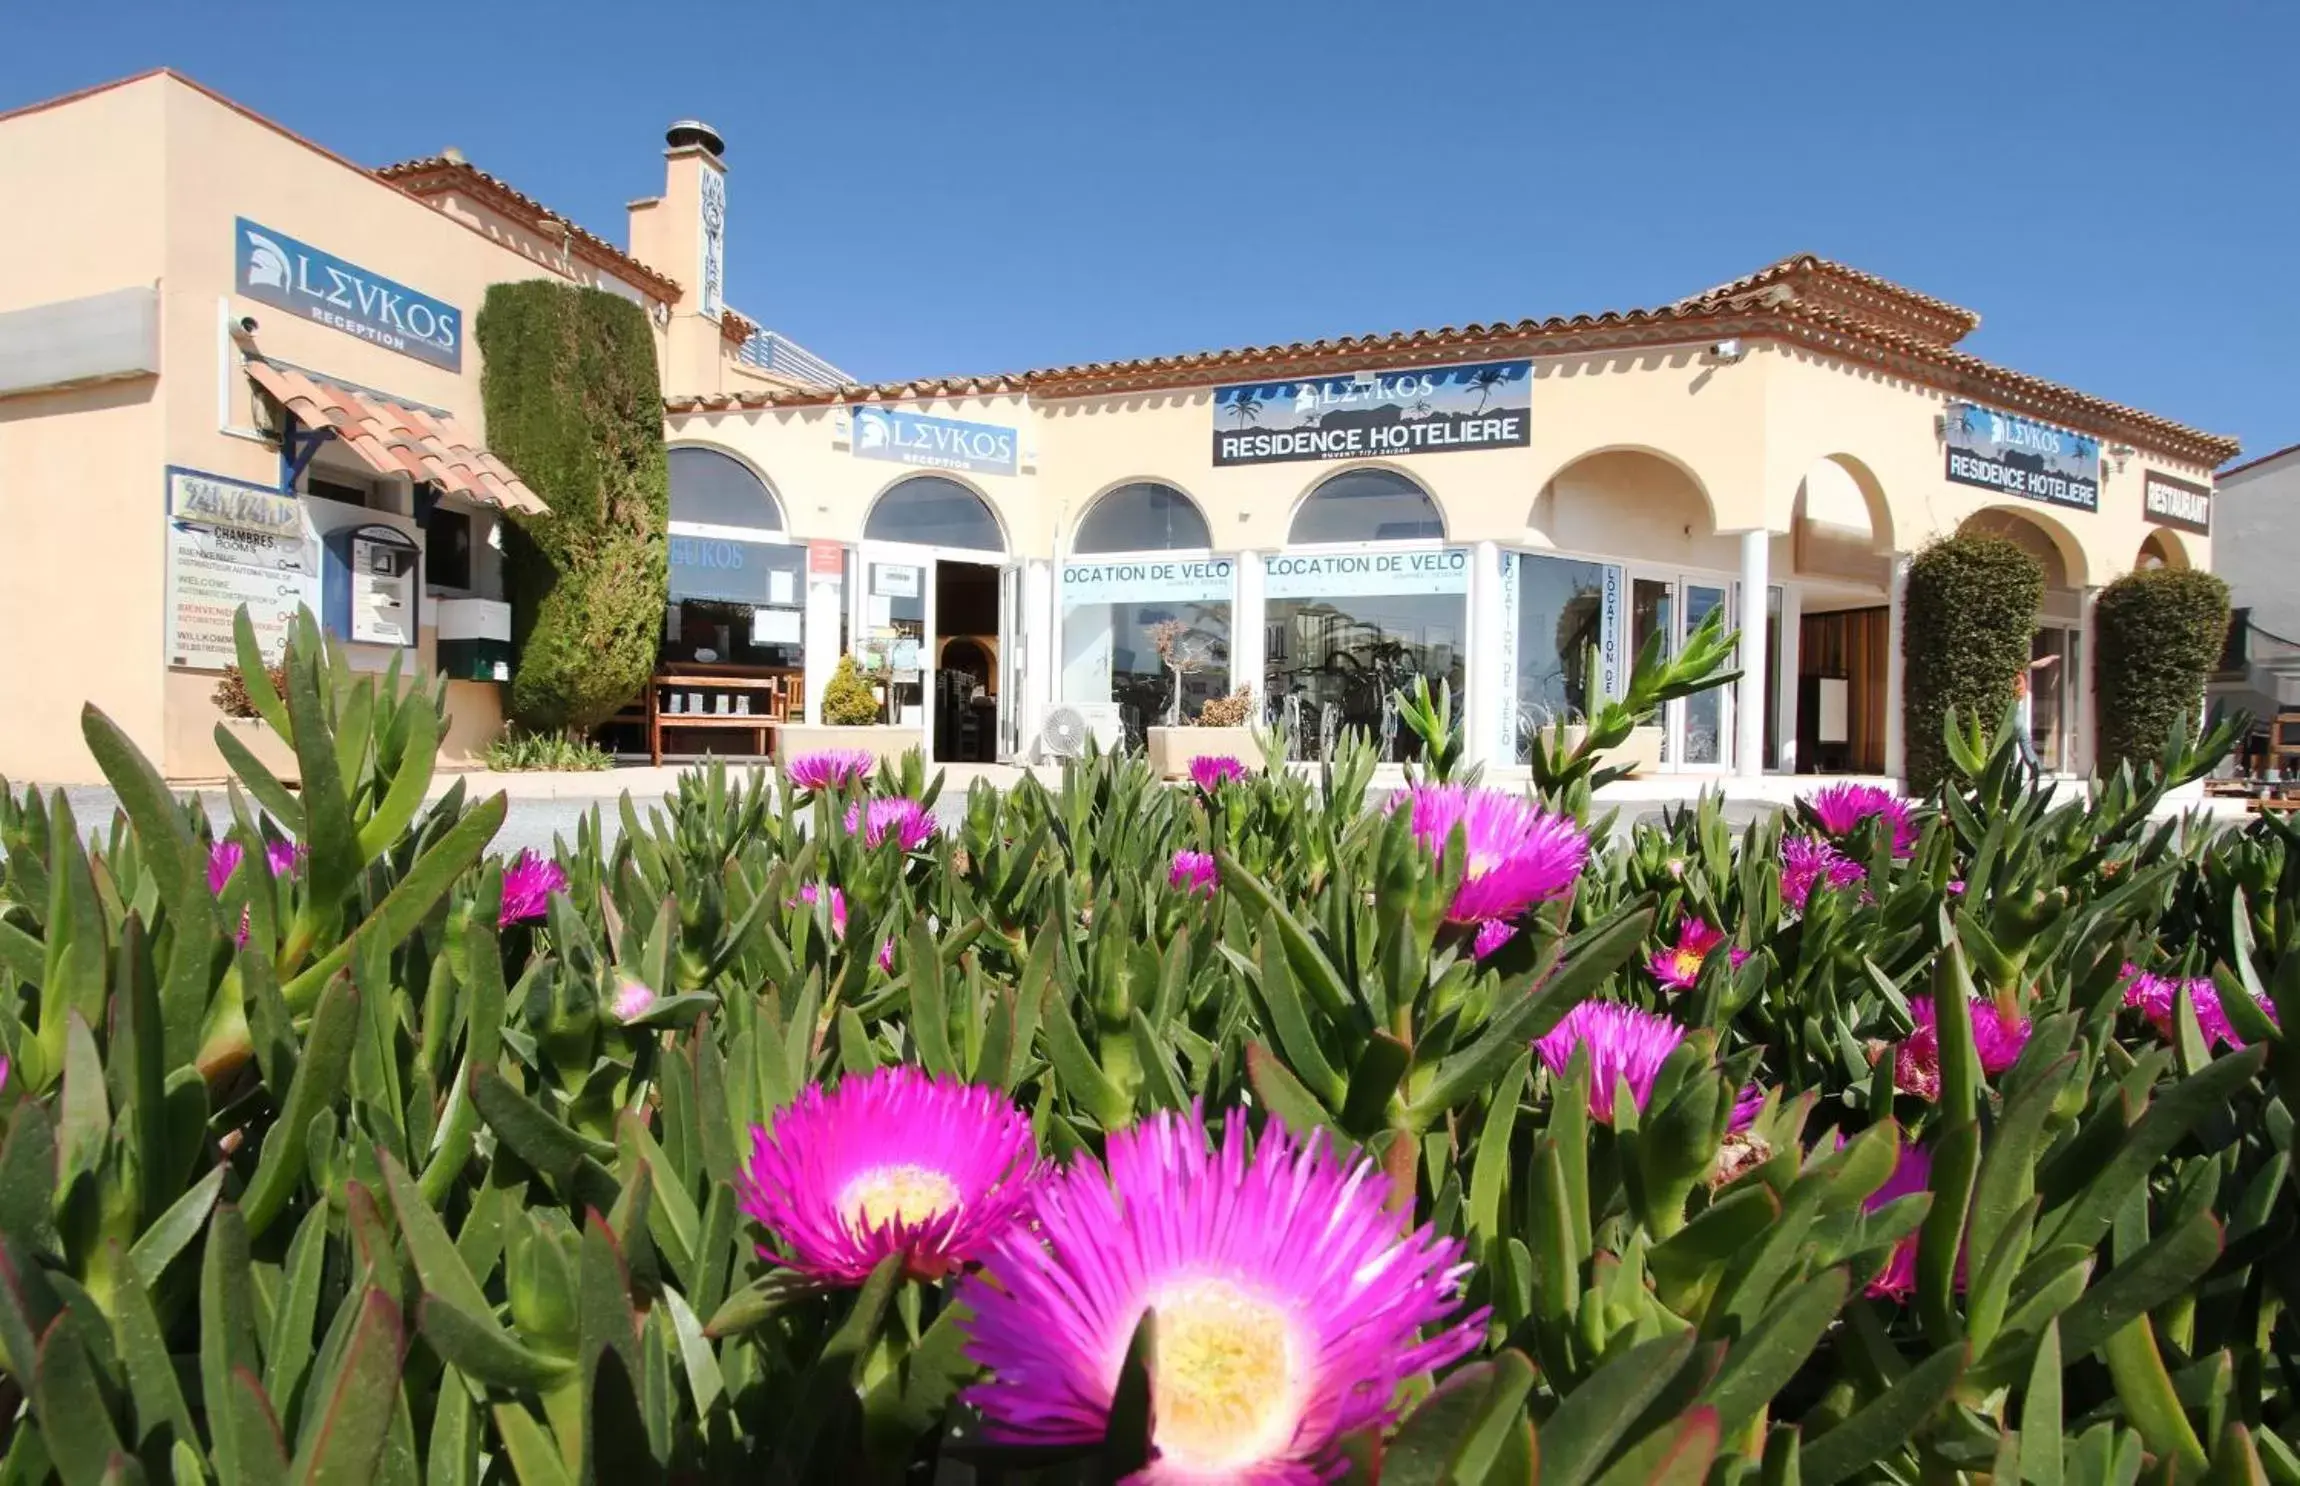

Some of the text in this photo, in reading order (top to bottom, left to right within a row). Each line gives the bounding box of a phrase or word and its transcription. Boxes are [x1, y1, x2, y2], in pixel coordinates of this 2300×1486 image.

[312, 306, 405, 350] RECEPTION
[1222, 417, 1520, 458] RESIDENCE HOTELIERE
[903, 453, 971, 470] RECEPTION
[1951, 454, 2094, 506] RESIDENCE HOTELIERE
[2147, 480, 2208, 525] RESTAURANT
[214, 526, 274, 549] CHAMBRES
[215, 537, 257, 554] ROOMS
[1151, 564, 1175, 581] DE
[1182, 561, 1231, 579] VELO
[1267, 552, 1465, 576] LOCATION DE VELO
[177, 575, 231, 589] WELCOME
[177, 603, 236, 617] BIENVENID
[177, 631, 235, 645] WILLKOMM
[1604, 568, 1616, 695] LOCATION DE
